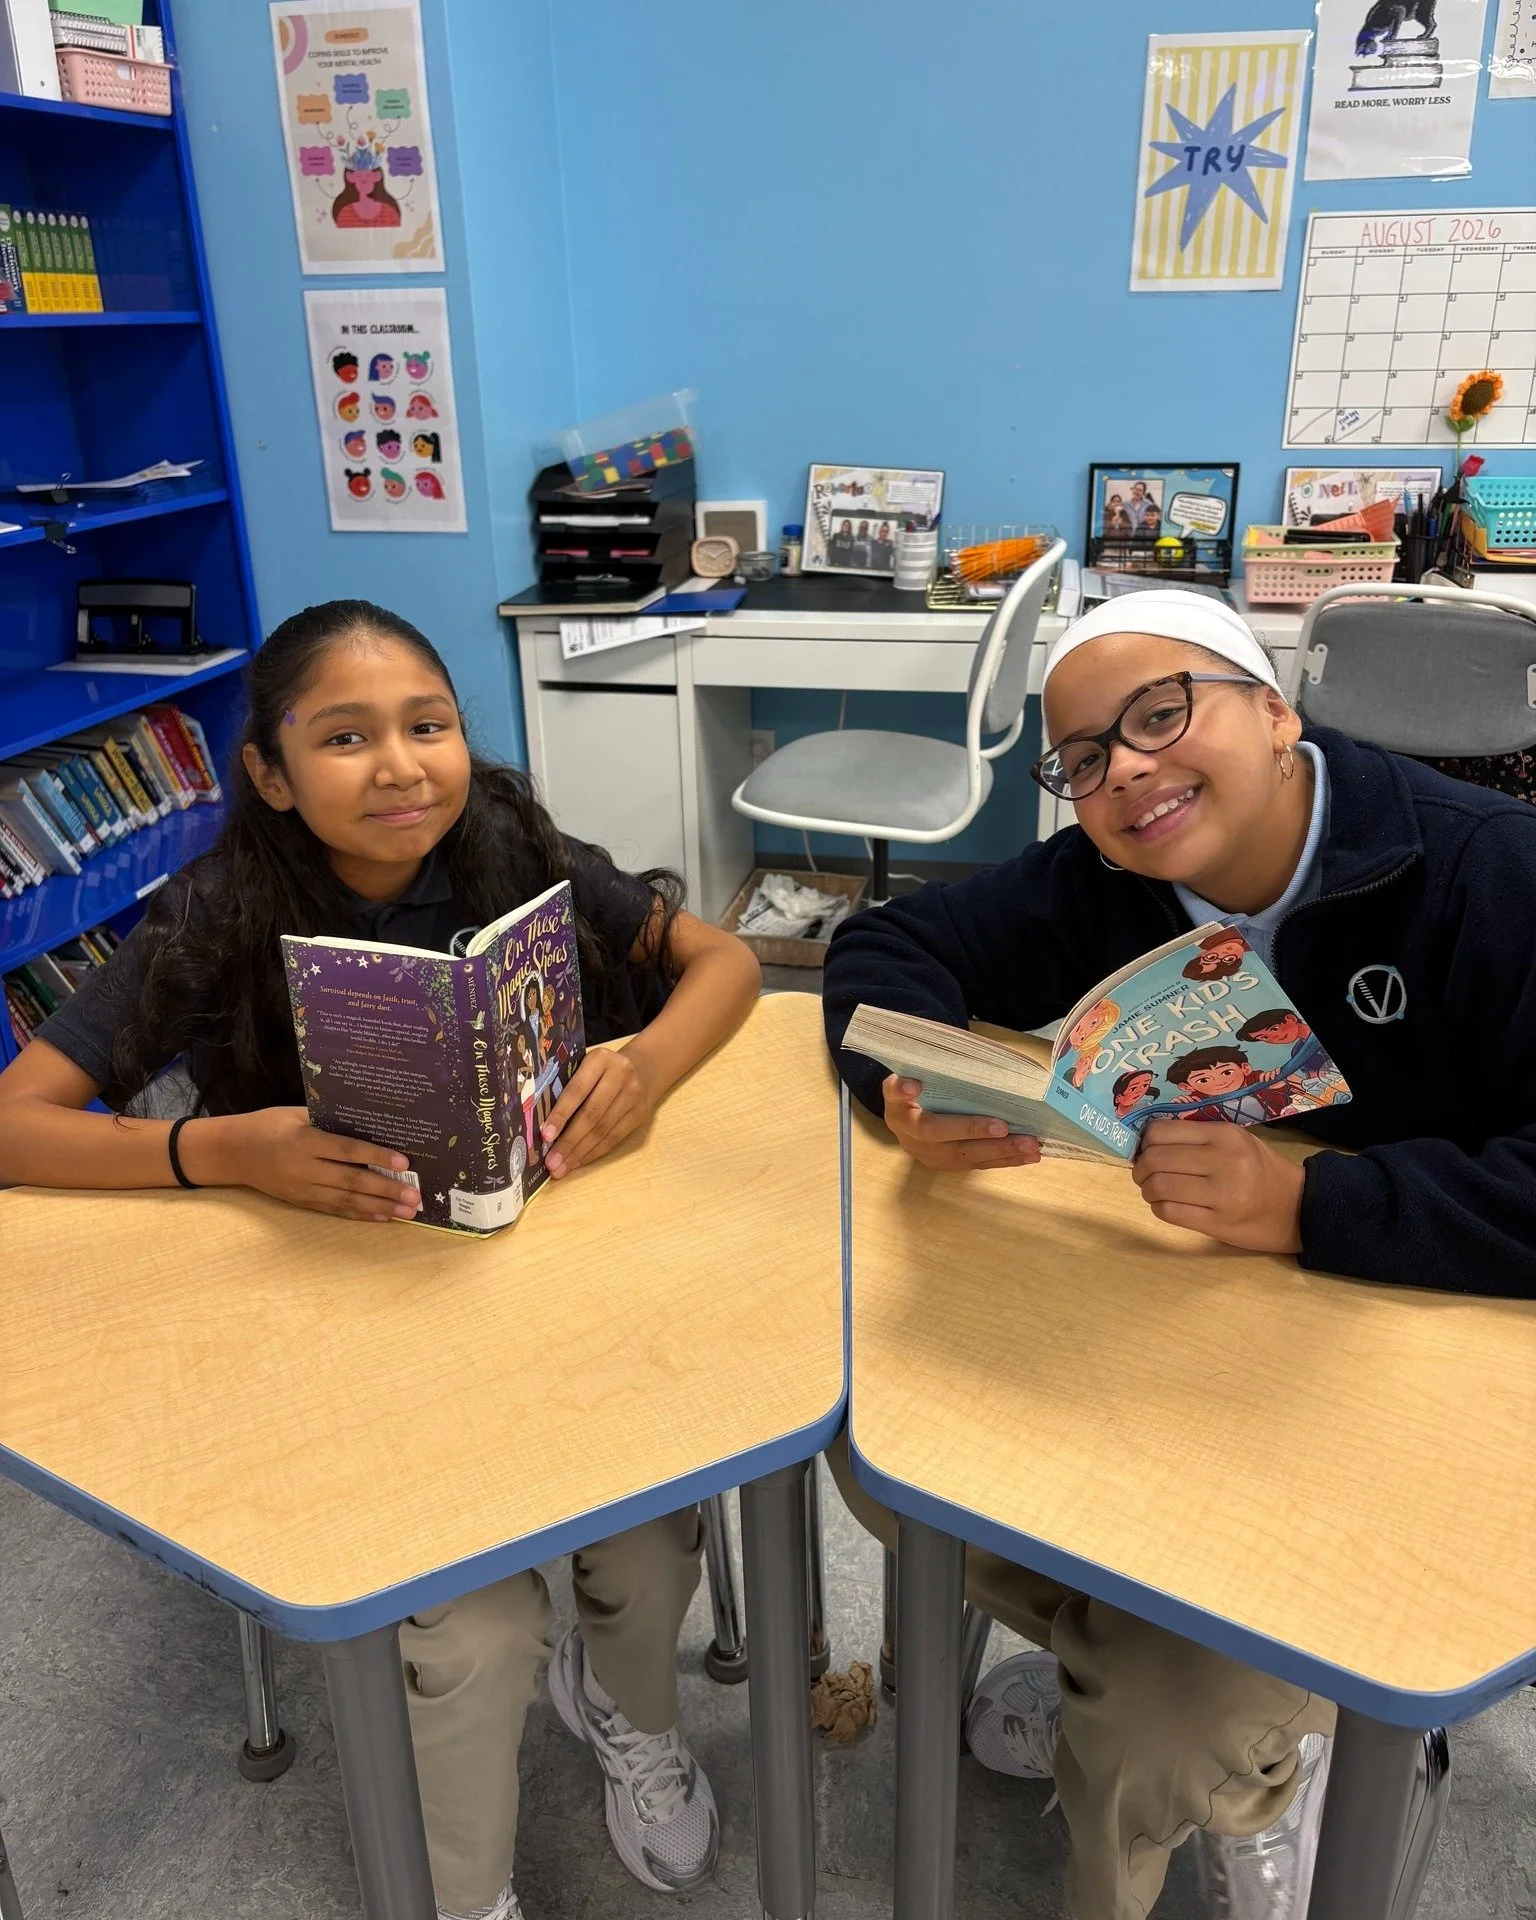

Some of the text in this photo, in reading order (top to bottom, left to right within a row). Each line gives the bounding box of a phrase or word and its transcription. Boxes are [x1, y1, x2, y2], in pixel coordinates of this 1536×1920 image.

[1334, 95, 1451, 109] READ MORE, WORRY LESS
[1184, 144, 1246, 176] TRY
[1361, 218, 1501, 247] AUGUST 2026
[351, 324, 367, 334] THIS
[502, 912, 560, 976] On These
[320, 986, 346, 996] Survival
[348, 989, 372, 1000] depends
[382, 994, 400, 1004] faith,
[401, 997, 418, 1006] trust,
[468, 976, 478, 1010] MÉNDEZ
[497, 940, 567, 1024] Magic Shores
[360, 1001, 375, 1010] fairy
[376, 1004, 392, 1012] dust.
[1091, 971, 1260, 1074] ONE KID'S
[1112, 984, 1190, 1034] JAMIE SUMNER
[1111, 1004, 1249, 1074] TRASH
[470, 1036, 500, 1171] On These Magic Shores
[1056, 1086, 1070, 1100] SUMNER
[1080, 1104, 1131, 1149] ONE KID'S TRASH
